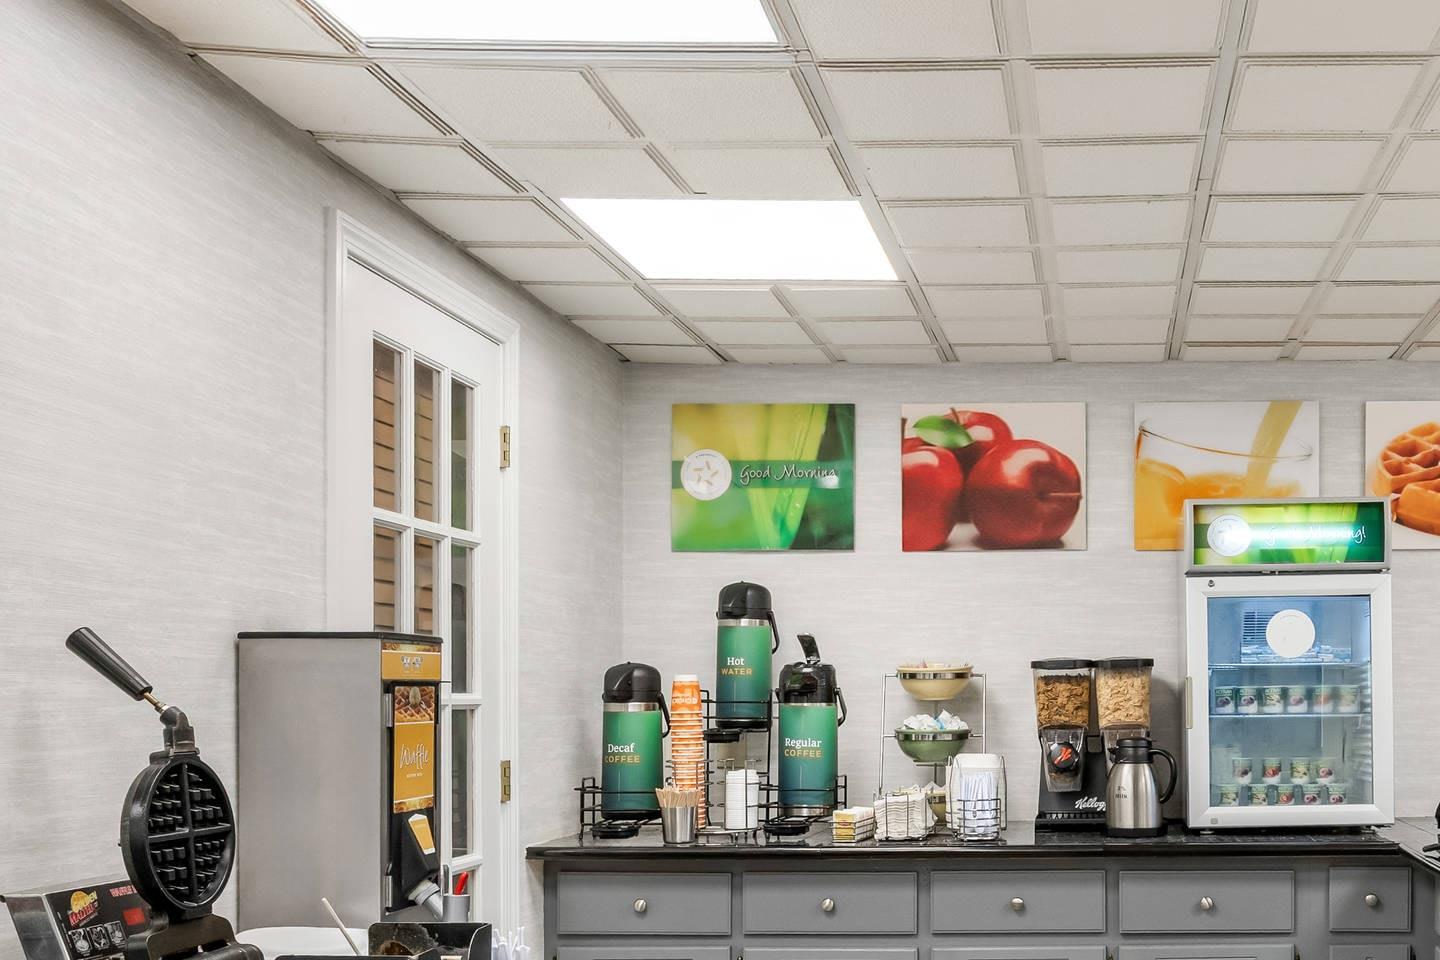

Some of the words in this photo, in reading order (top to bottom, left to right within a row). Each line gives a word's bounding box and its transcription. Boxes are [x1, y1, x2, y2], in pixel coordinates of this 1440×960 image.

[740, 465, 771, 485] Good
[727, 657, 745, 666] Hot
[721, 668, 752, 676] WATER
[607, 743, 636, 753] Decaf
[785, 738, 822, 749] Regular
[399, 743, 429, 770] Waffle
[784, 749, 822, 758] COFFEE
